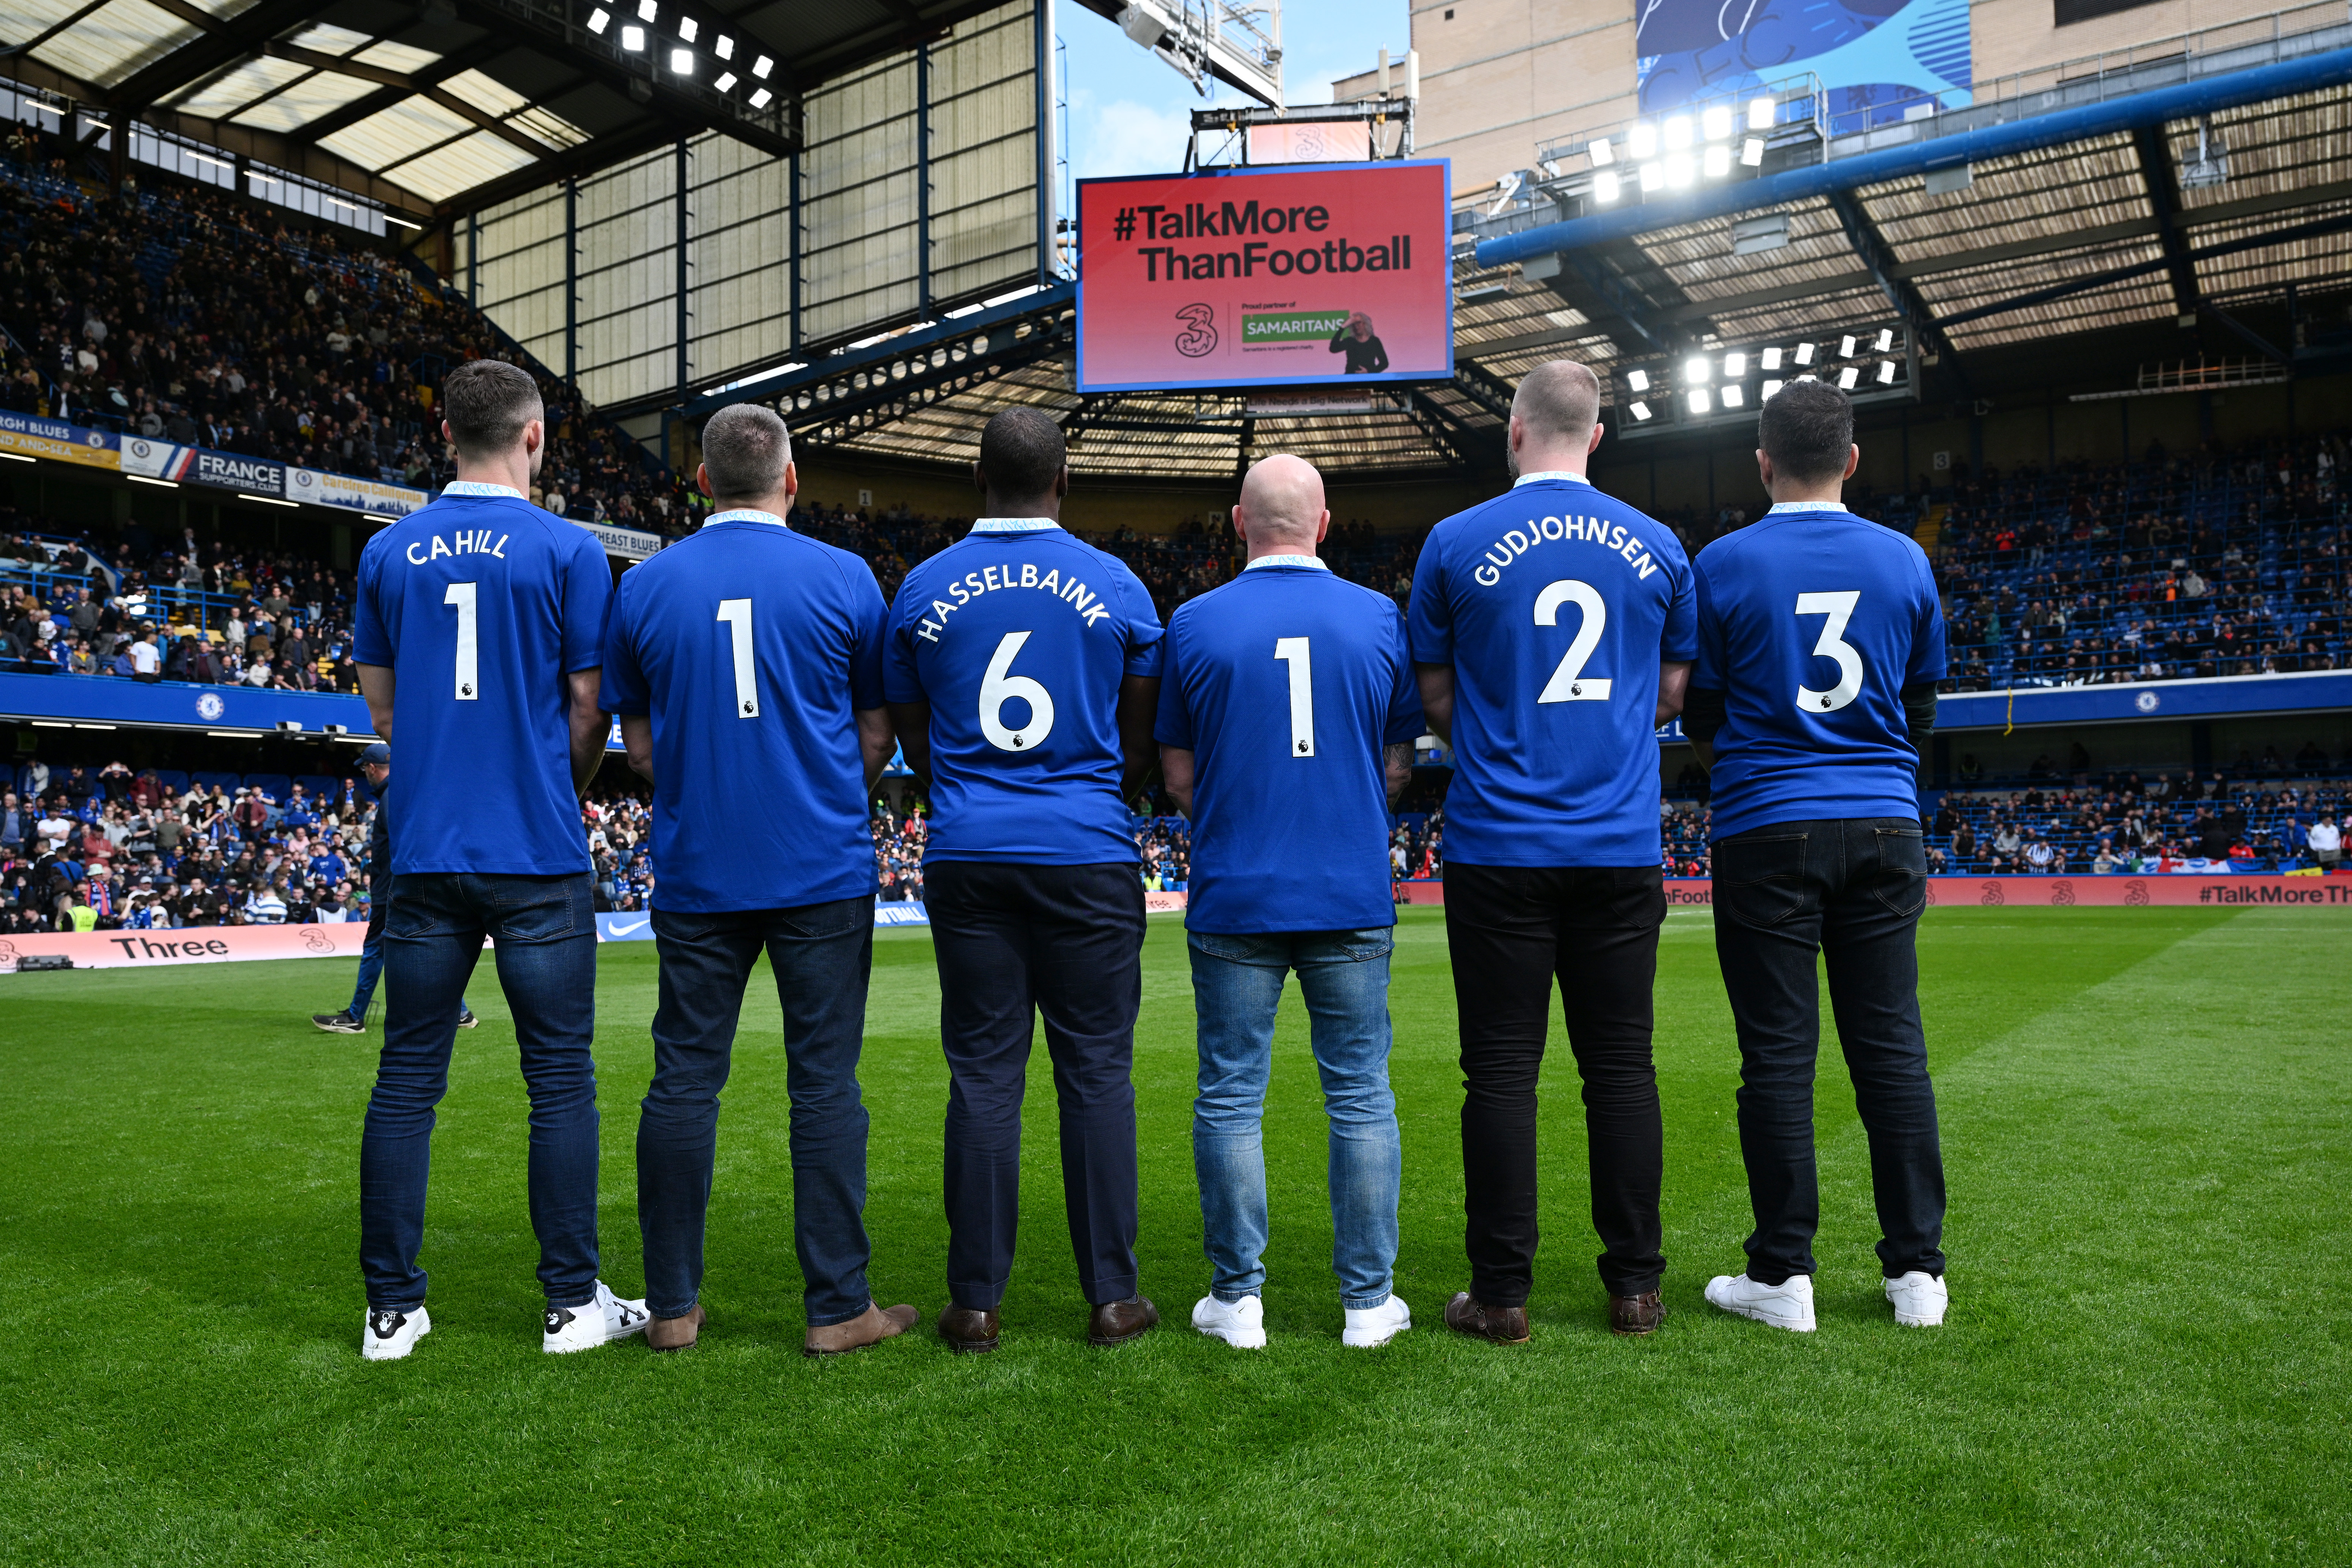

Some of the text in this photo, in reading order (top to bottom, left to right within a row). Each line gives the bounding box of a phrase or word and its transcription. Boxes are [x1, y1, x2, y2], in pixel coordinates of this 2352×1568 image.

[1114, 200, 1329, 241] #TalkMore
[1138, 235, 1411, 282] ThanFootball
[1175, 303, 1218, 357] 3
[1247, 319, 1345, 335] SAMARITANS
[1250, 397, 1266, 406] Life
[1269, 396, 1299, 406] Needs
[1310, 396, 1325, 406] Big
[1329, 395, 1367, 404] Network
[19, 439, 46, 452] AND
[50, 444, 72, 456] SEA
[29, 422, 70, 439] BLUES
[199, 455, 281, 484] FRANCE
[199, 472, 281, 493] SUPPORTERS CLUB
[322, 474, 370, 494] Carefree
[371, 483, 422, 503] California
[406, 530, 509, 566] CAHILL
[631, 537, 659, 552] BLUES
[1474, 514, 1658, 586] GUDJOHNSEN
[917, 563, 1111, 643] HASSELBAINK
[443, 582, 478, 700] 1
[716, 598, 760, 719] 1
[1533, 579, 1612, 704] 2
[1794, 590, 1864, 713] 3
[978, 631, 1054, 752] 6
[1274, 636, 1315, 757] 1
[1665, 889, 1712, 903] nFoot
[110, 937, 229, 959] Three
[382, 1312, 398, 1320] Off
